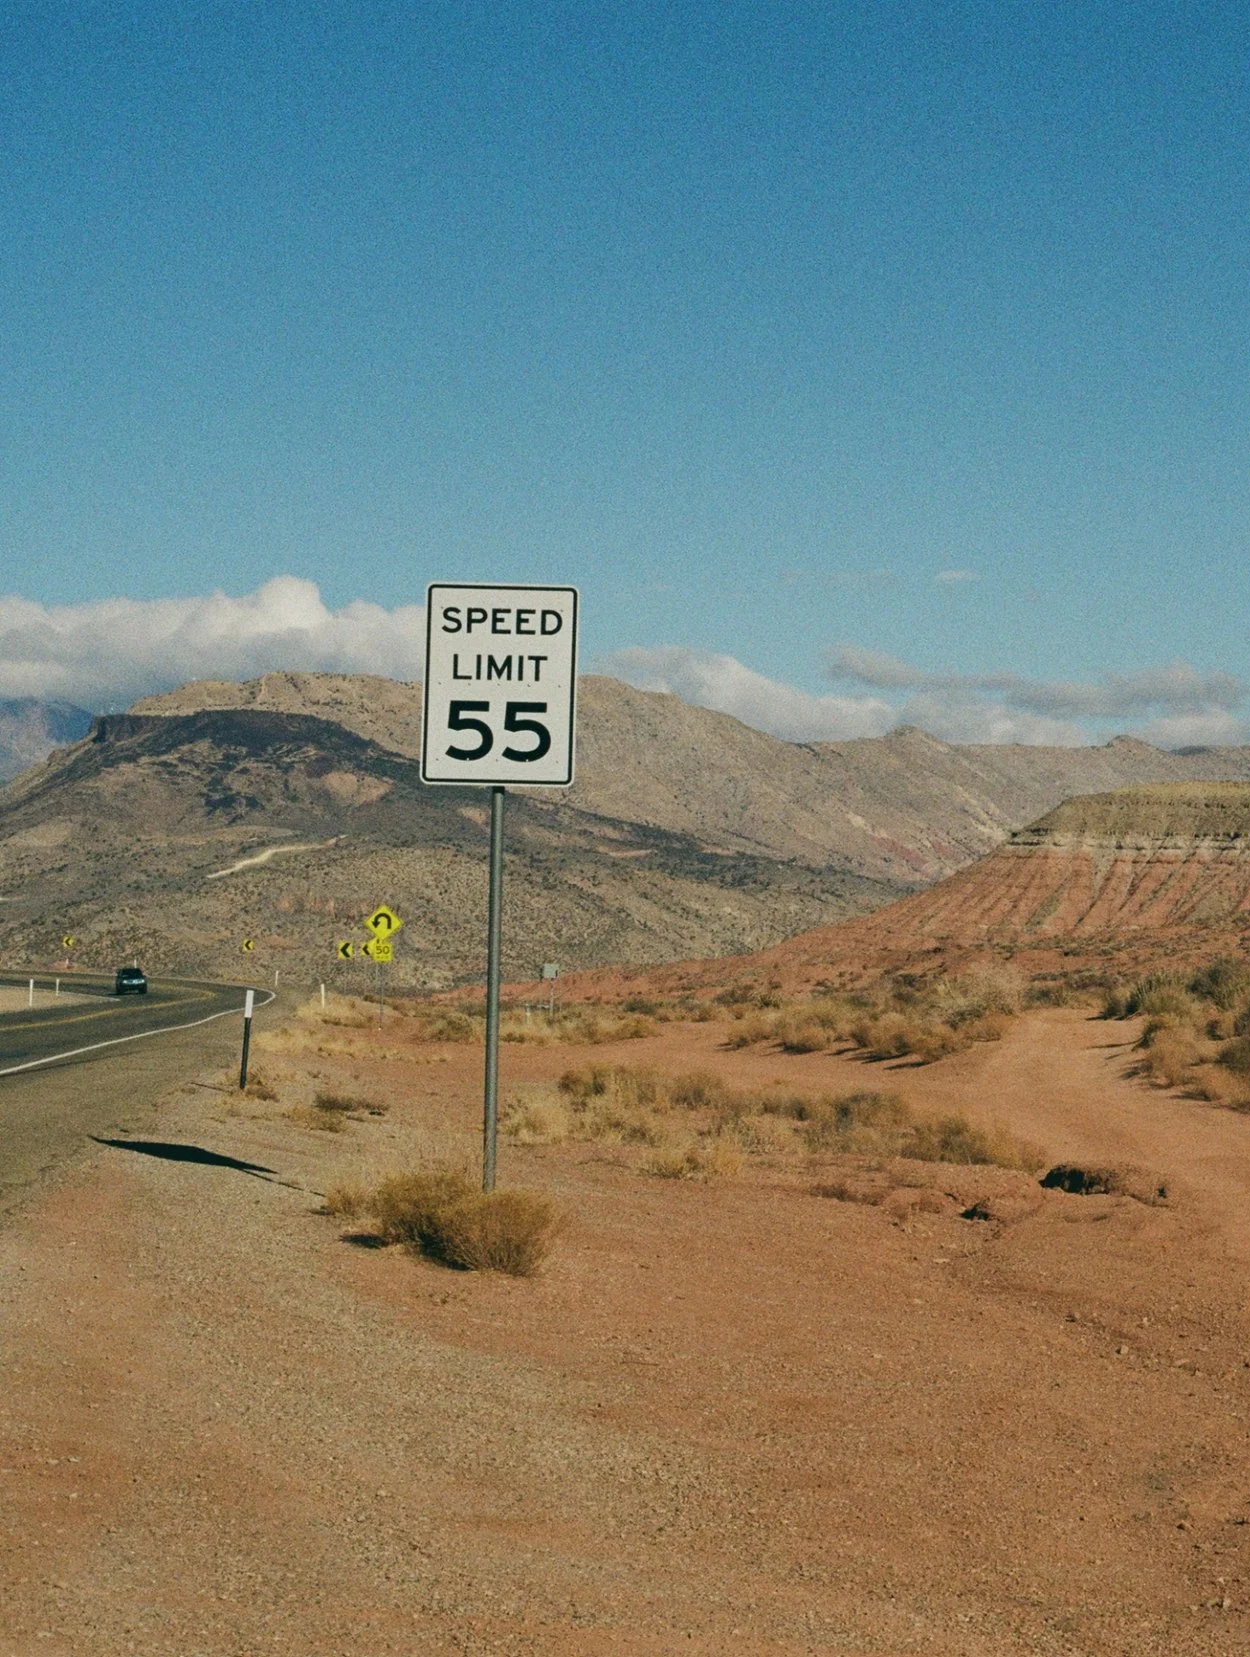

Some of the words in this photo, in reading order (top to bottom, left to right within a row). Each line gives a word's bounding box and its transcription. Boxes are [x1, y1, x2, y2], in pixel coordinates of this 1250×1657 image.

[441, 606, 563, 635] SPEED
[453, 653, 548, 682] LIMIT
[445, 700, 552, 763] 55
